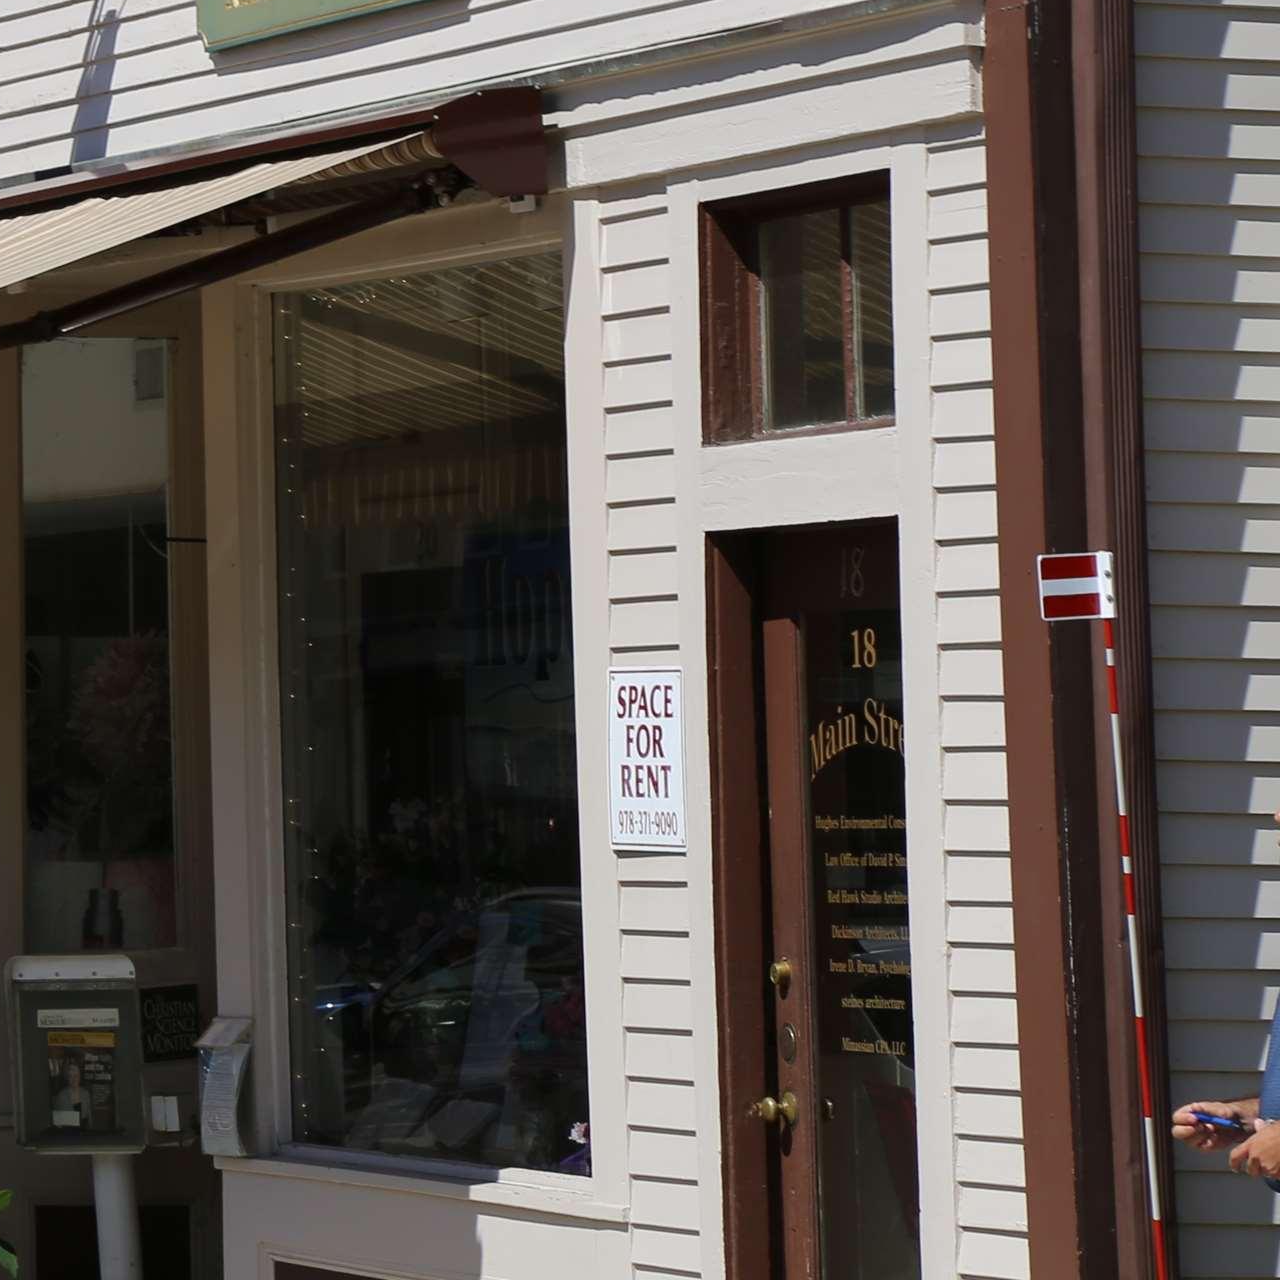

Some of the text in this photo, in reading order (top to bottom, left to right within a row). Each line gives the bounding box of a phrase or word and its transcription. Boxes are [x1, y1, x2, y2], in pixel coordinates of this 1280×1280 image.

[850, 628, 877, 669] 18
[617, 685, 674, 719] SPACE
[626, 724, 665, 758] FOR
[810, 705, 858, 782] Main
[620, 764, 672, 799] RENT
[618, 810, 678, 836] 978-371-9090
